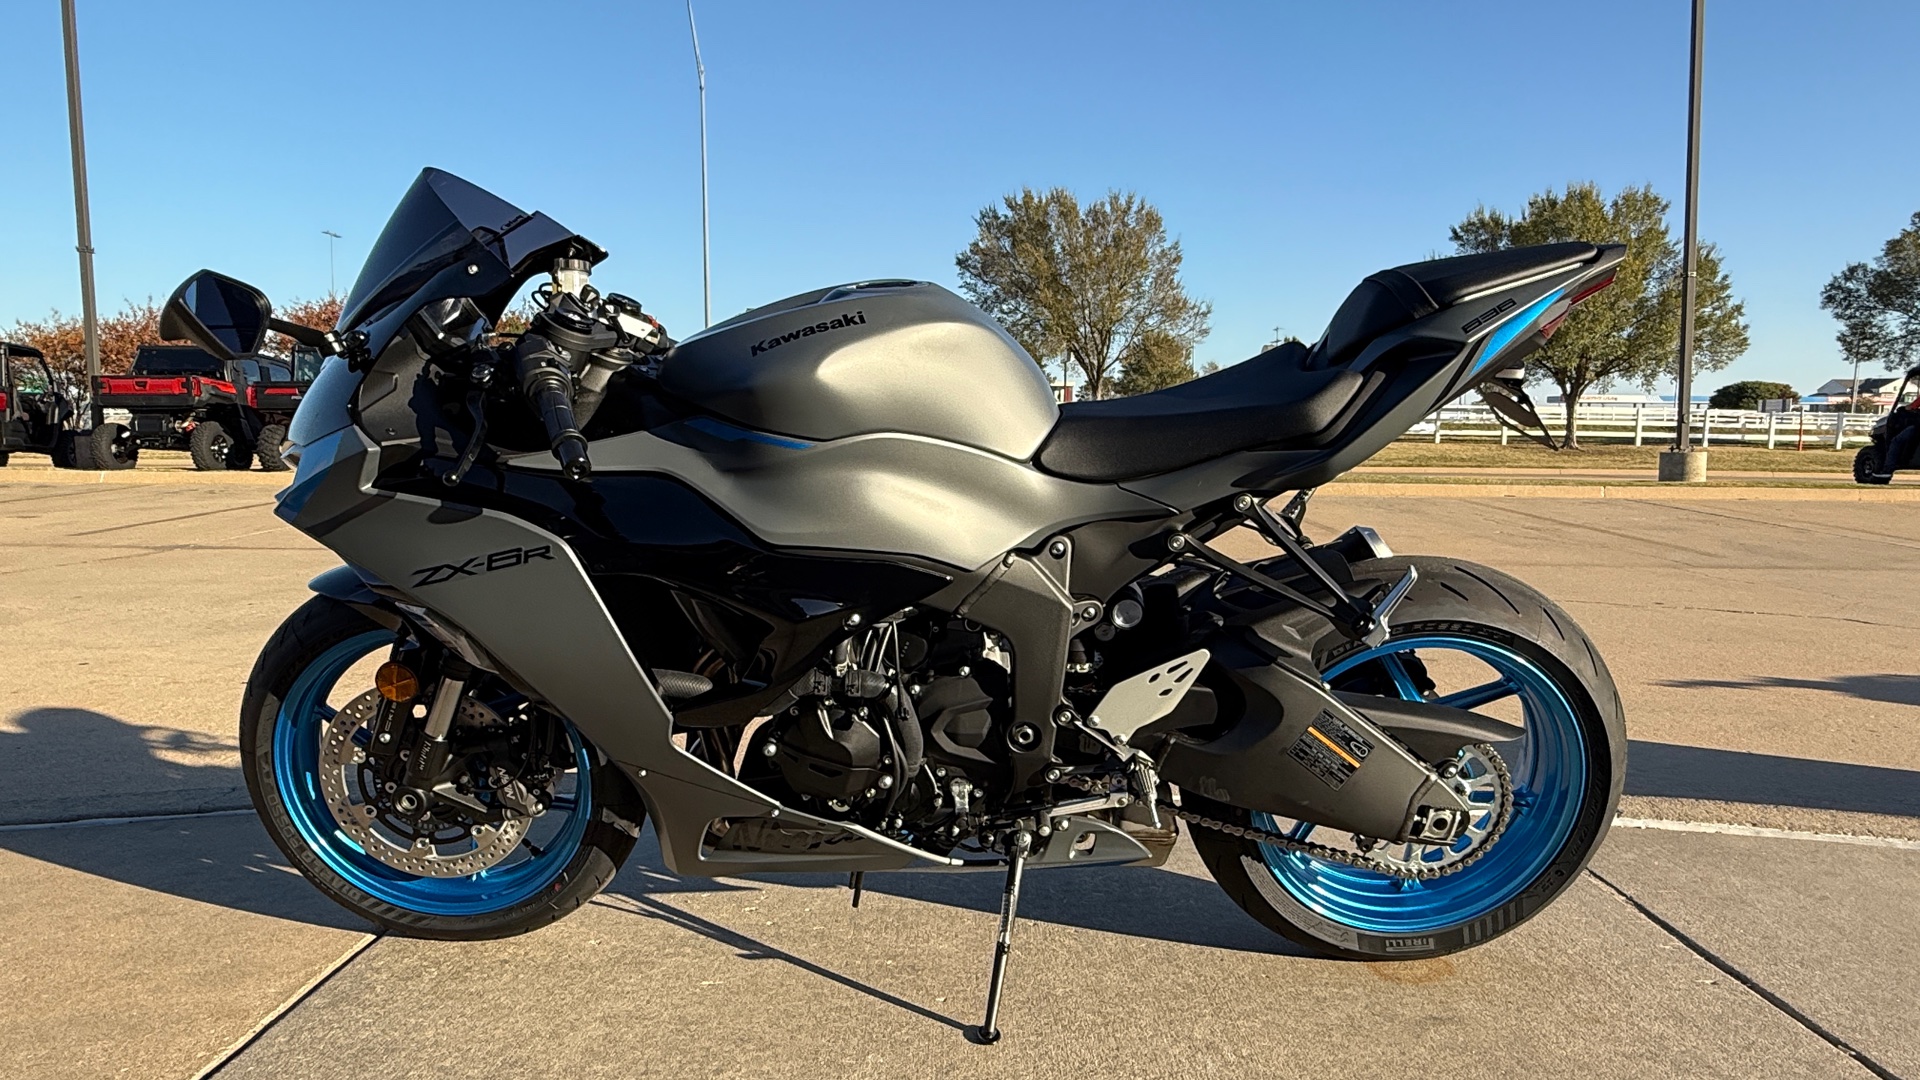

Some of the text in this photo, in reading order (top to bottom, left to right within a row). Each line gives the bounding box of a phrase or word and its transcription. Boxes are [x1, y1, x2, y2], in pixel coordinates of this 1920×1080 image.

[750, 311, 867, 357] Kawasaki
[1461, 298, 1517, 334] 636
[411, 545, 556, 588] ZX-6R
[1385, 938, 1434, 952] PIRELLI
